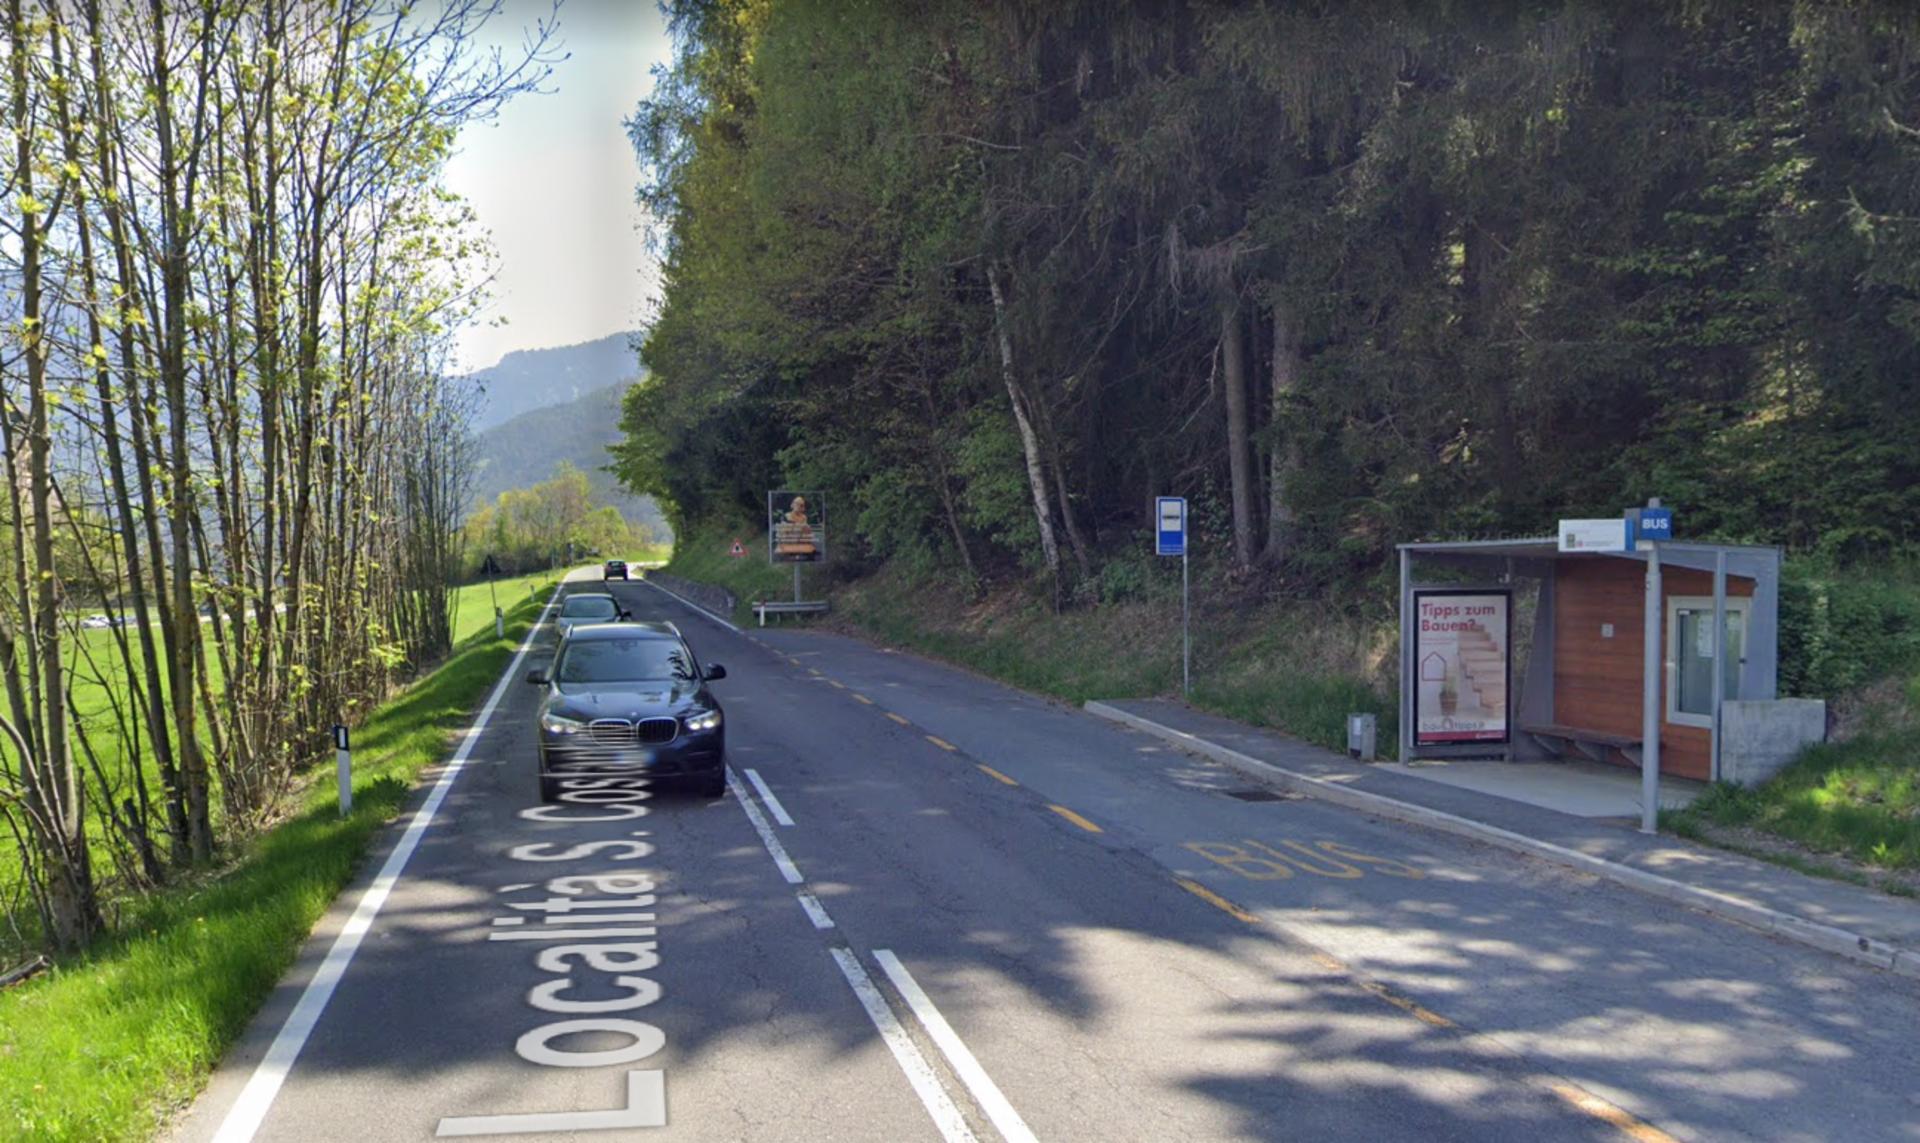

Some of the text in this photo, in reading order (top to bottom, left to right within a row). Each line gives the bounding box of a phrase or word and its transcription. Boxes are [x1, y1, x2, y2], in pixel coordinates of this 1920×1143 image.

[1642, 518, 1668, 529] BUS
[1421, 603, 1495, 619] Tipps zum
[1421, 619, 1476, 632] Bauen?
[1180, 838, 1425, 880] BUS
